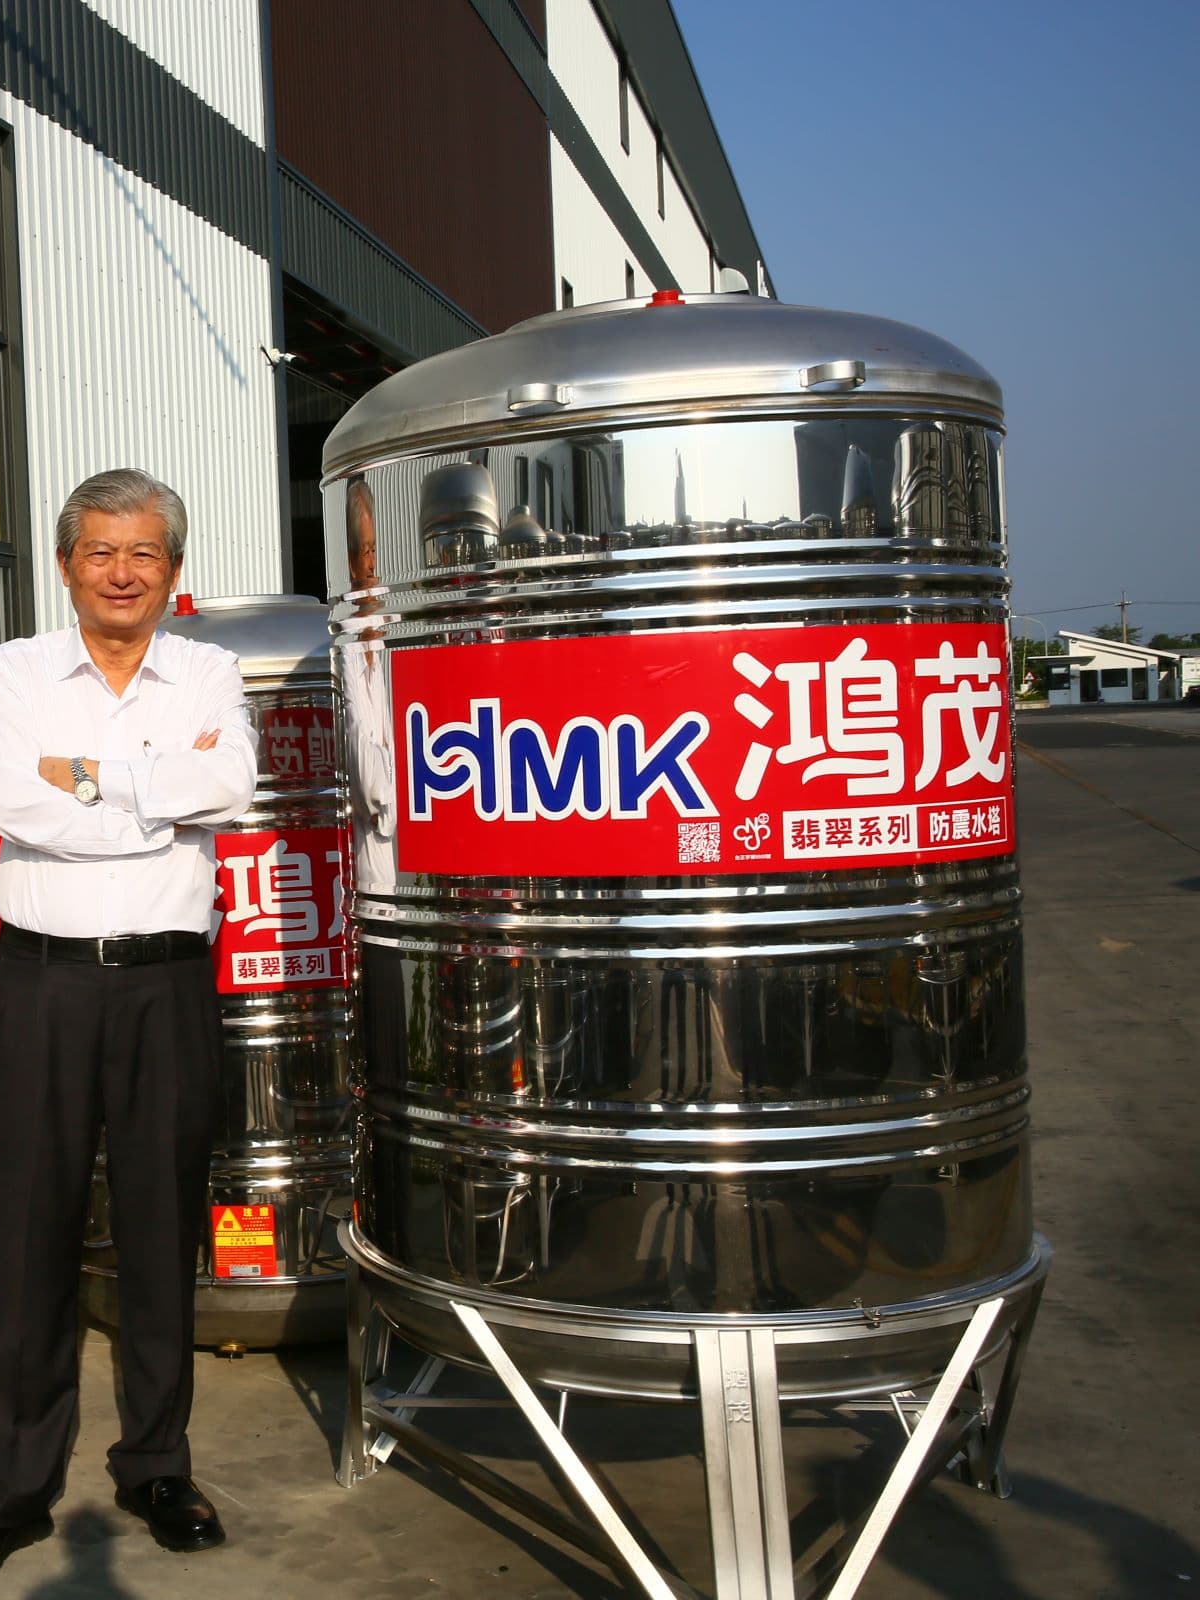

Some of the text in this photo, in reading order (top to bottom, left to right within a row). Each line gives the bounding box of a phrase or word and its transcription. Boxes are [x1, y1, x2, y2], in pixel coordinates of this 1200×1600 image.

[406, 698, 720, 823] HMK
[732, 637, 1007, 801] 鴻茂
[791, 805, 1001, 850] 翡翠系列 防震水塔
[209, 838, 343, 946] 鴻
[237, 954, 325, 979] 翡翠系列
